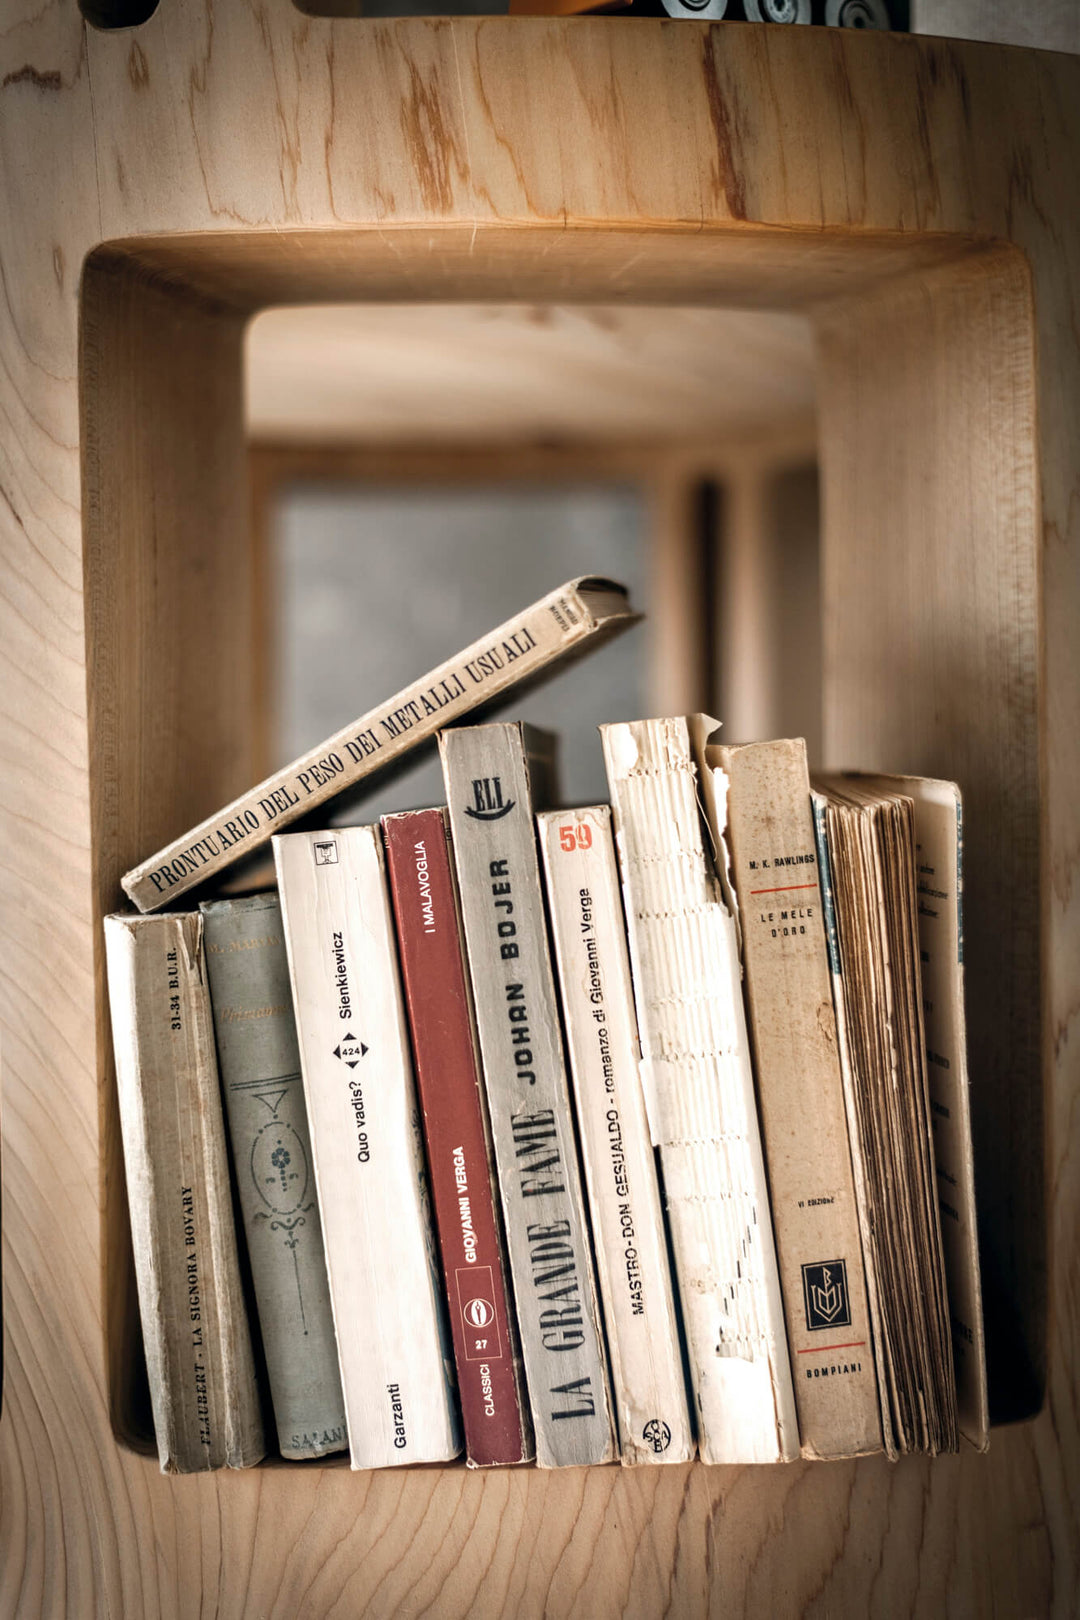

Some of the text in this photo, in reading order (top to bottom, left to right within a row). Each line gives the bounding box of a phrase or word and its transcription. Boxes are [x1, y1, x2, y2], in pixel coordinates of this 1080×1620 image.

[148, 627, 537, 893] PRONTUARIO DEL PESO DEI METALLI USUALI
[414, 840, 435, 926] MALAVOGLIA
[749, 854, 815, 870] M. K. RAWLINGS
[761, 908, 813, 922] LE MELE
[771, 925, 806, 938] D'ORO
[167, 947, 182, 1030] 31-34 B.U.R.
[331, 931, 352, 1020] Sienkiewicz
[583, 937, 605, 1004] Giovanni
[592, 1009, 604, 1023] di
[342, 1047, 360, 1056] 424
[598, 1028, 615, 1093] romanzo
[348, 1081, 370, 1163] Quo vadis?
[489, 859, 595, 1421] LA GRANDE FAME JOHAN BOJER
[606, 1109, 629, 1196] GESUALDO
[182, 1186, 196, 1246] BOVARY
[453, 1145, 477, 1263] GIOVANNI VERGA
[186, 1253, 201, 1321] SIGNORA
[192, 1327, 203, 1346] LA
[475, 1339, 488, 1350] 27
[480, 1364, 494, 1416] CLASSICI
[806, 1362, 862, 1378] BOMPIANI
[386, 1382, 407, 1449] Garzanti
